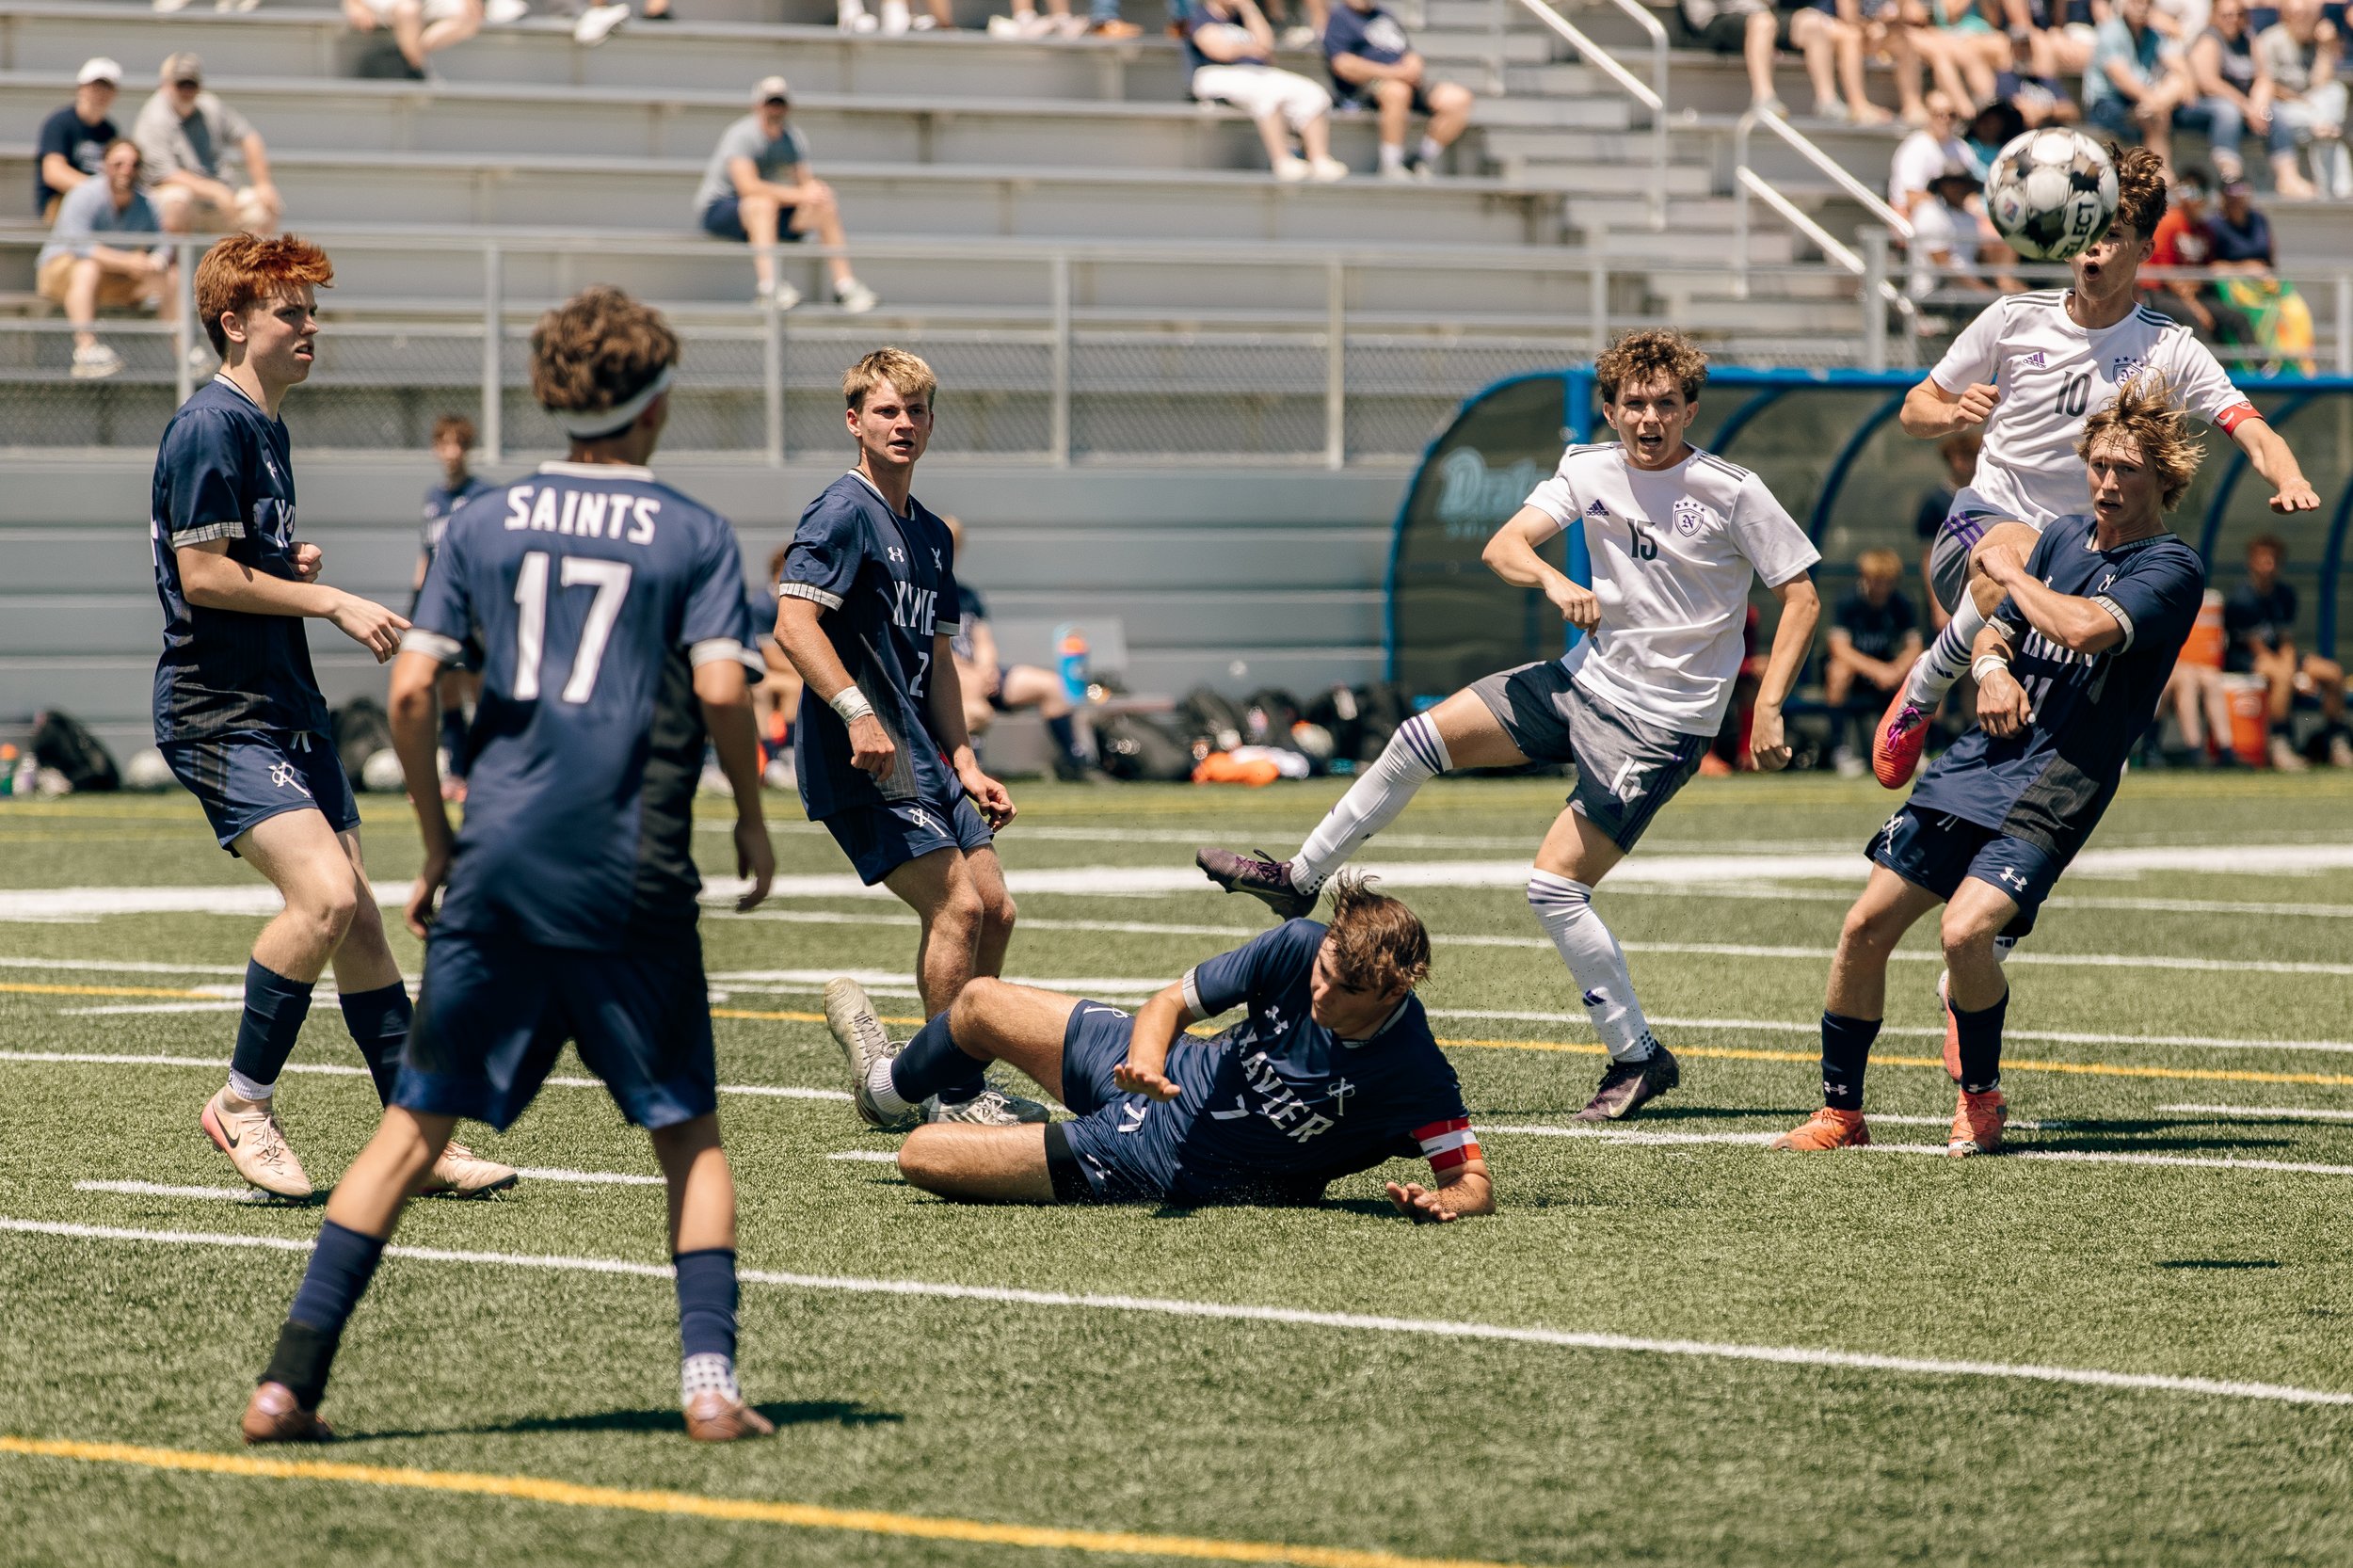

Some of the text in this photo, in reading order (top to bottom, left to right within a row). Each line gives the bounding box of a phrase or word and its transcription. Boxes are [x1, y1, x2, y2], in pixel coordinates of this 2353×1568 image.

[2055, 370, 2092, 417] 10
[504, 485, 661, 546] SAINTS
[1625, 517, 1658, 561] 15
[513, 551, 632, 704] 17
[909, 651, 930, 698] 2
[1609, 755, 1651, 805] 15
[1210, 1094, 1251, 1120] 7
